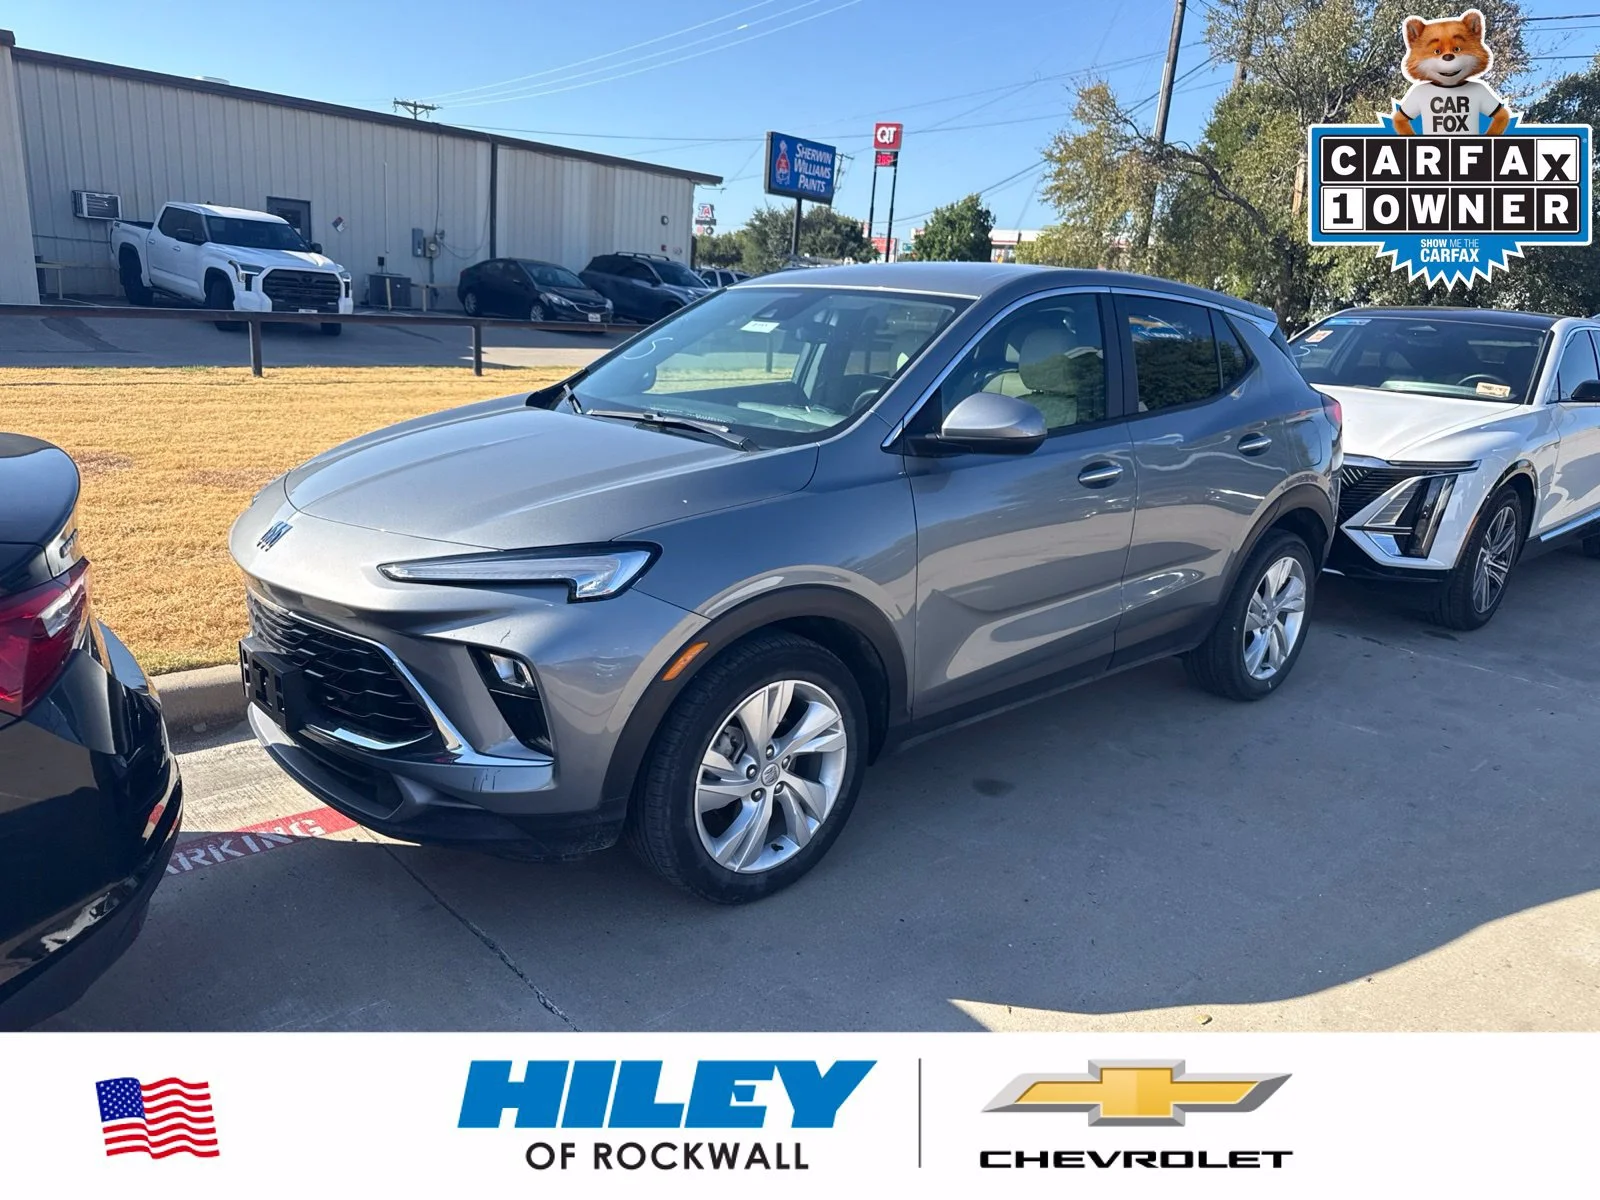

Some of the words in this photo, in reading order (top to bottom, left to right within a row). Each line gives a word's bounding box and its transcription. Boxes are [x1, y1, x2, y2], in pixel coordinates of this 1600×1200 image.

[877, 126, 897, 144] QT
[795, 143, 833, 165] SHERWIN
[794, 157, 832, 179] WILLIAMS
[798, 174, 826, 193] PAINTS
